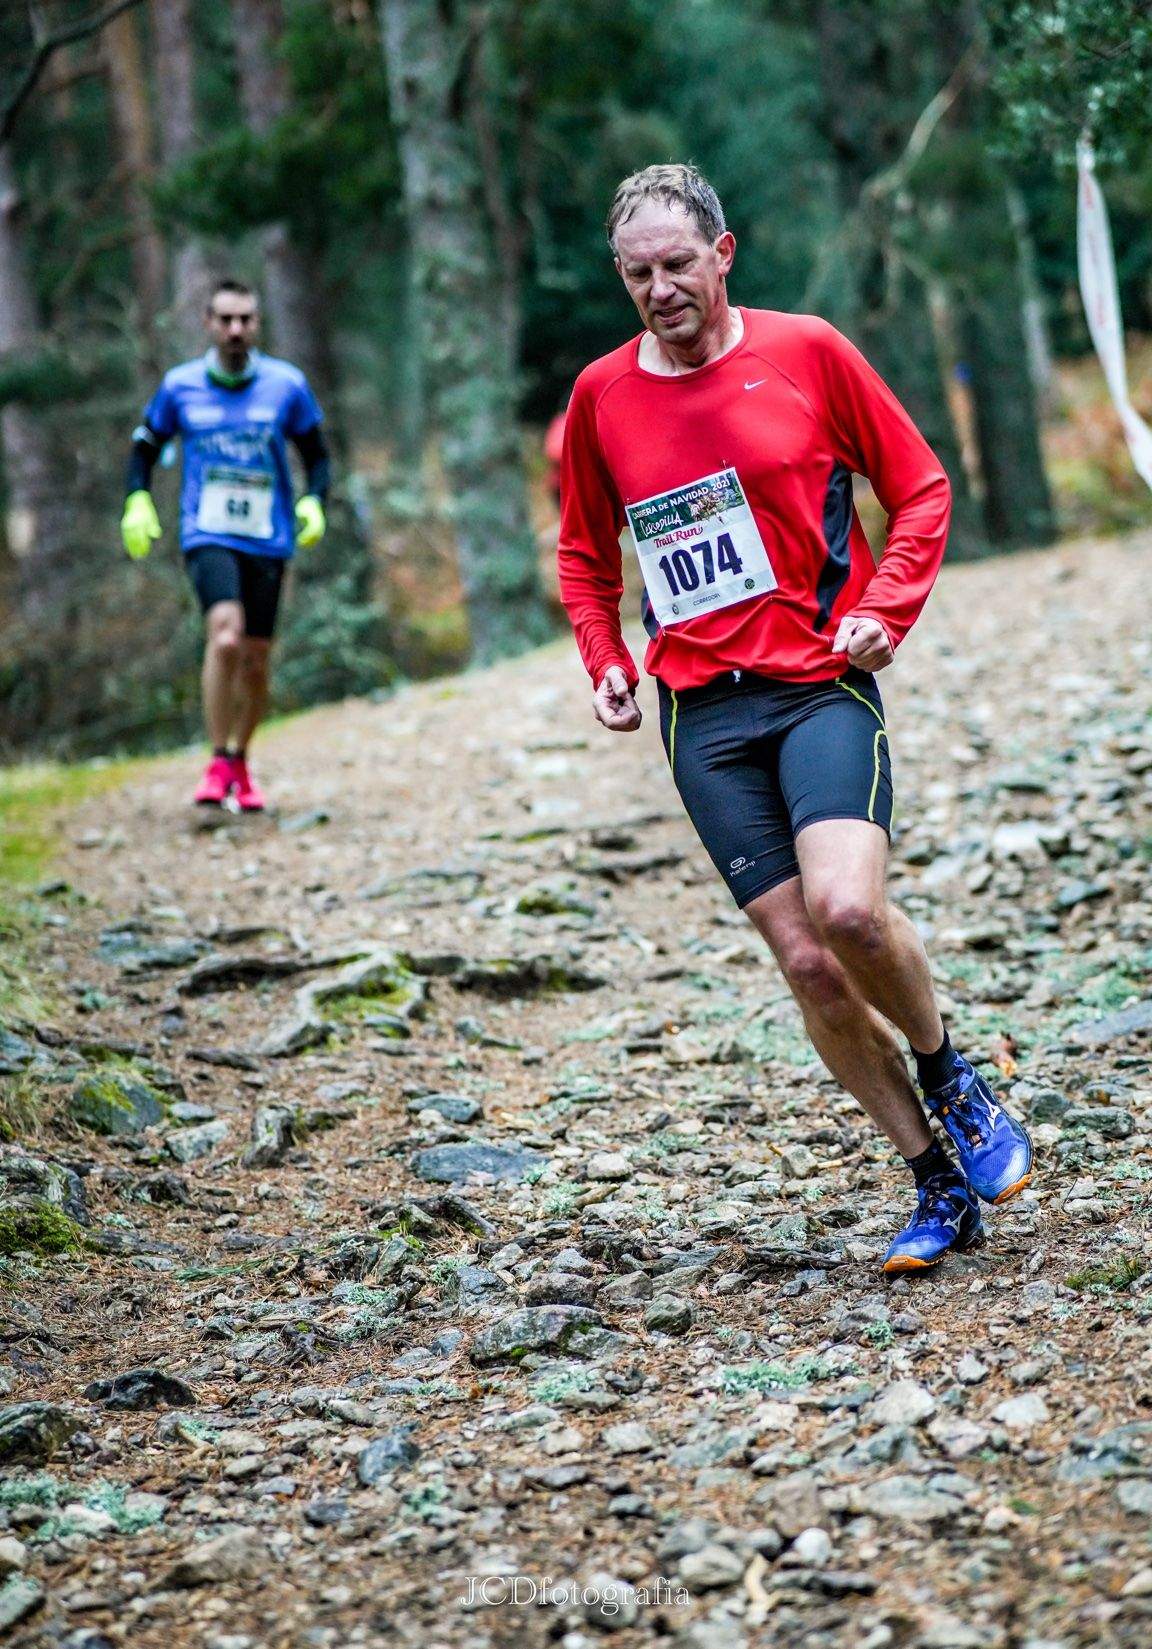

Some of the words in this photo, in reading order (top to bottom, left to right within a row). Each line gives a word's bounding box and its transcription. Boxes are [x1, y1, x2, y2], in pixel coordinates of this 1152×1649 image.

[658, 503, 669, 511] DE
[669, 486, 709, 507] NAVIDAD
[711, 479, 731, 491] 2021
[653, 533, 675, 548] Trail
[658, 532, 743, 597] 1074
